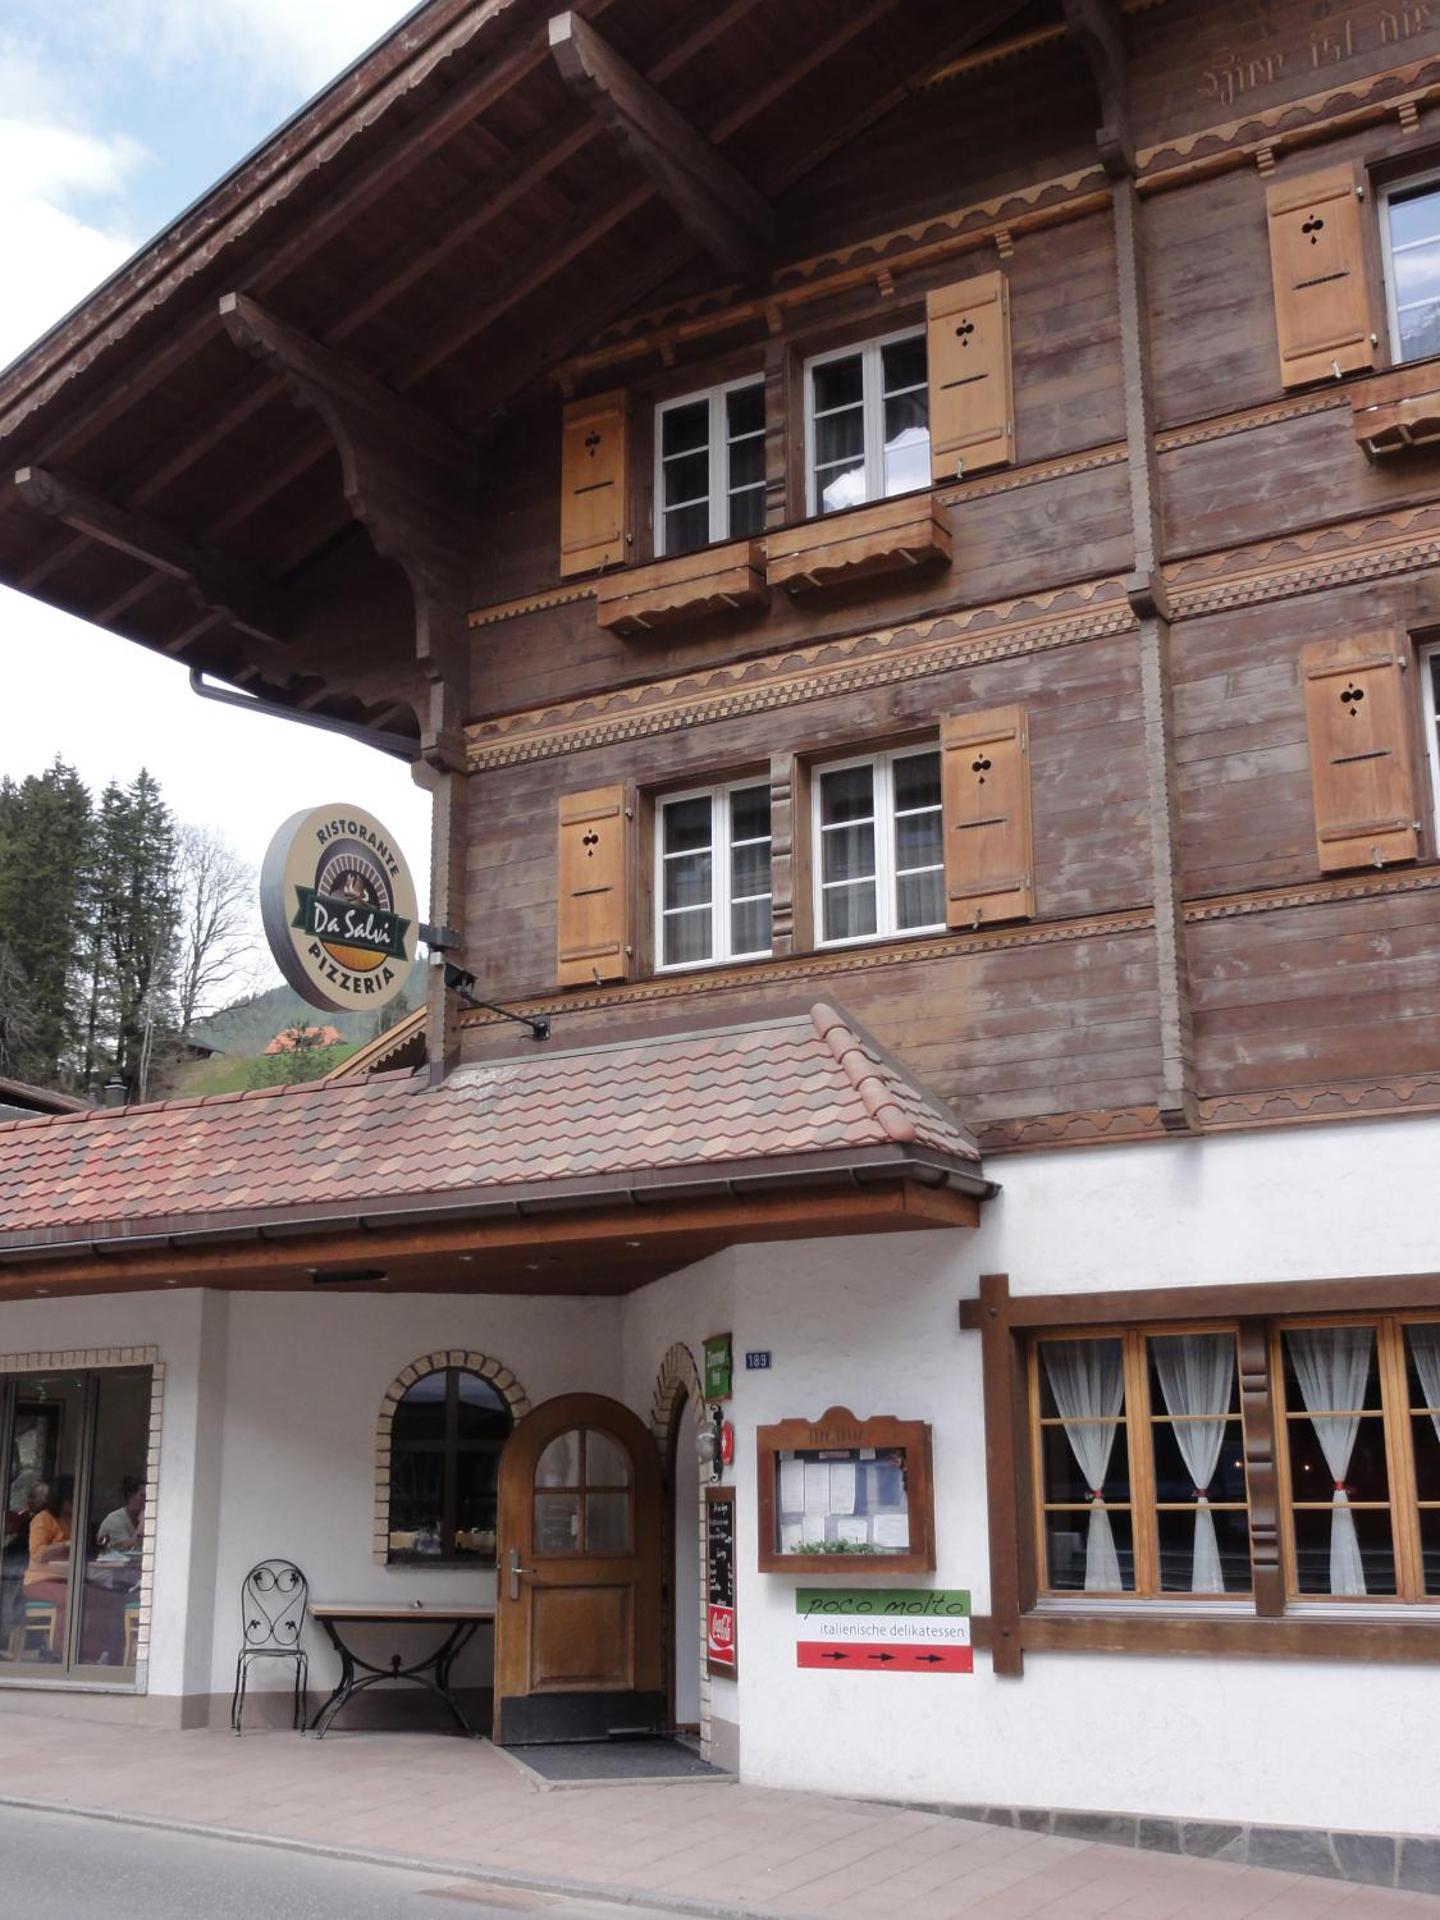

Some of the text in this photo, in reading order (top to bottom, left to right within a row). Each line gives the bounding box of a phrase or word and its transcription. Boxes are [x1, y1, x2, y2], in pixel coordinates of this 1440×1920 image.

[316, 819, 399, 878] RISTORANTE
[314, 902, 391, 943] Da Salvi
[308, 941, 395, 994] PIZZERIA
[746, 1354, 767, 1368] 189
[804, 1591, 963, 1620] poco molto
[820, 1623, 965, 1638] italienische delikatessen
